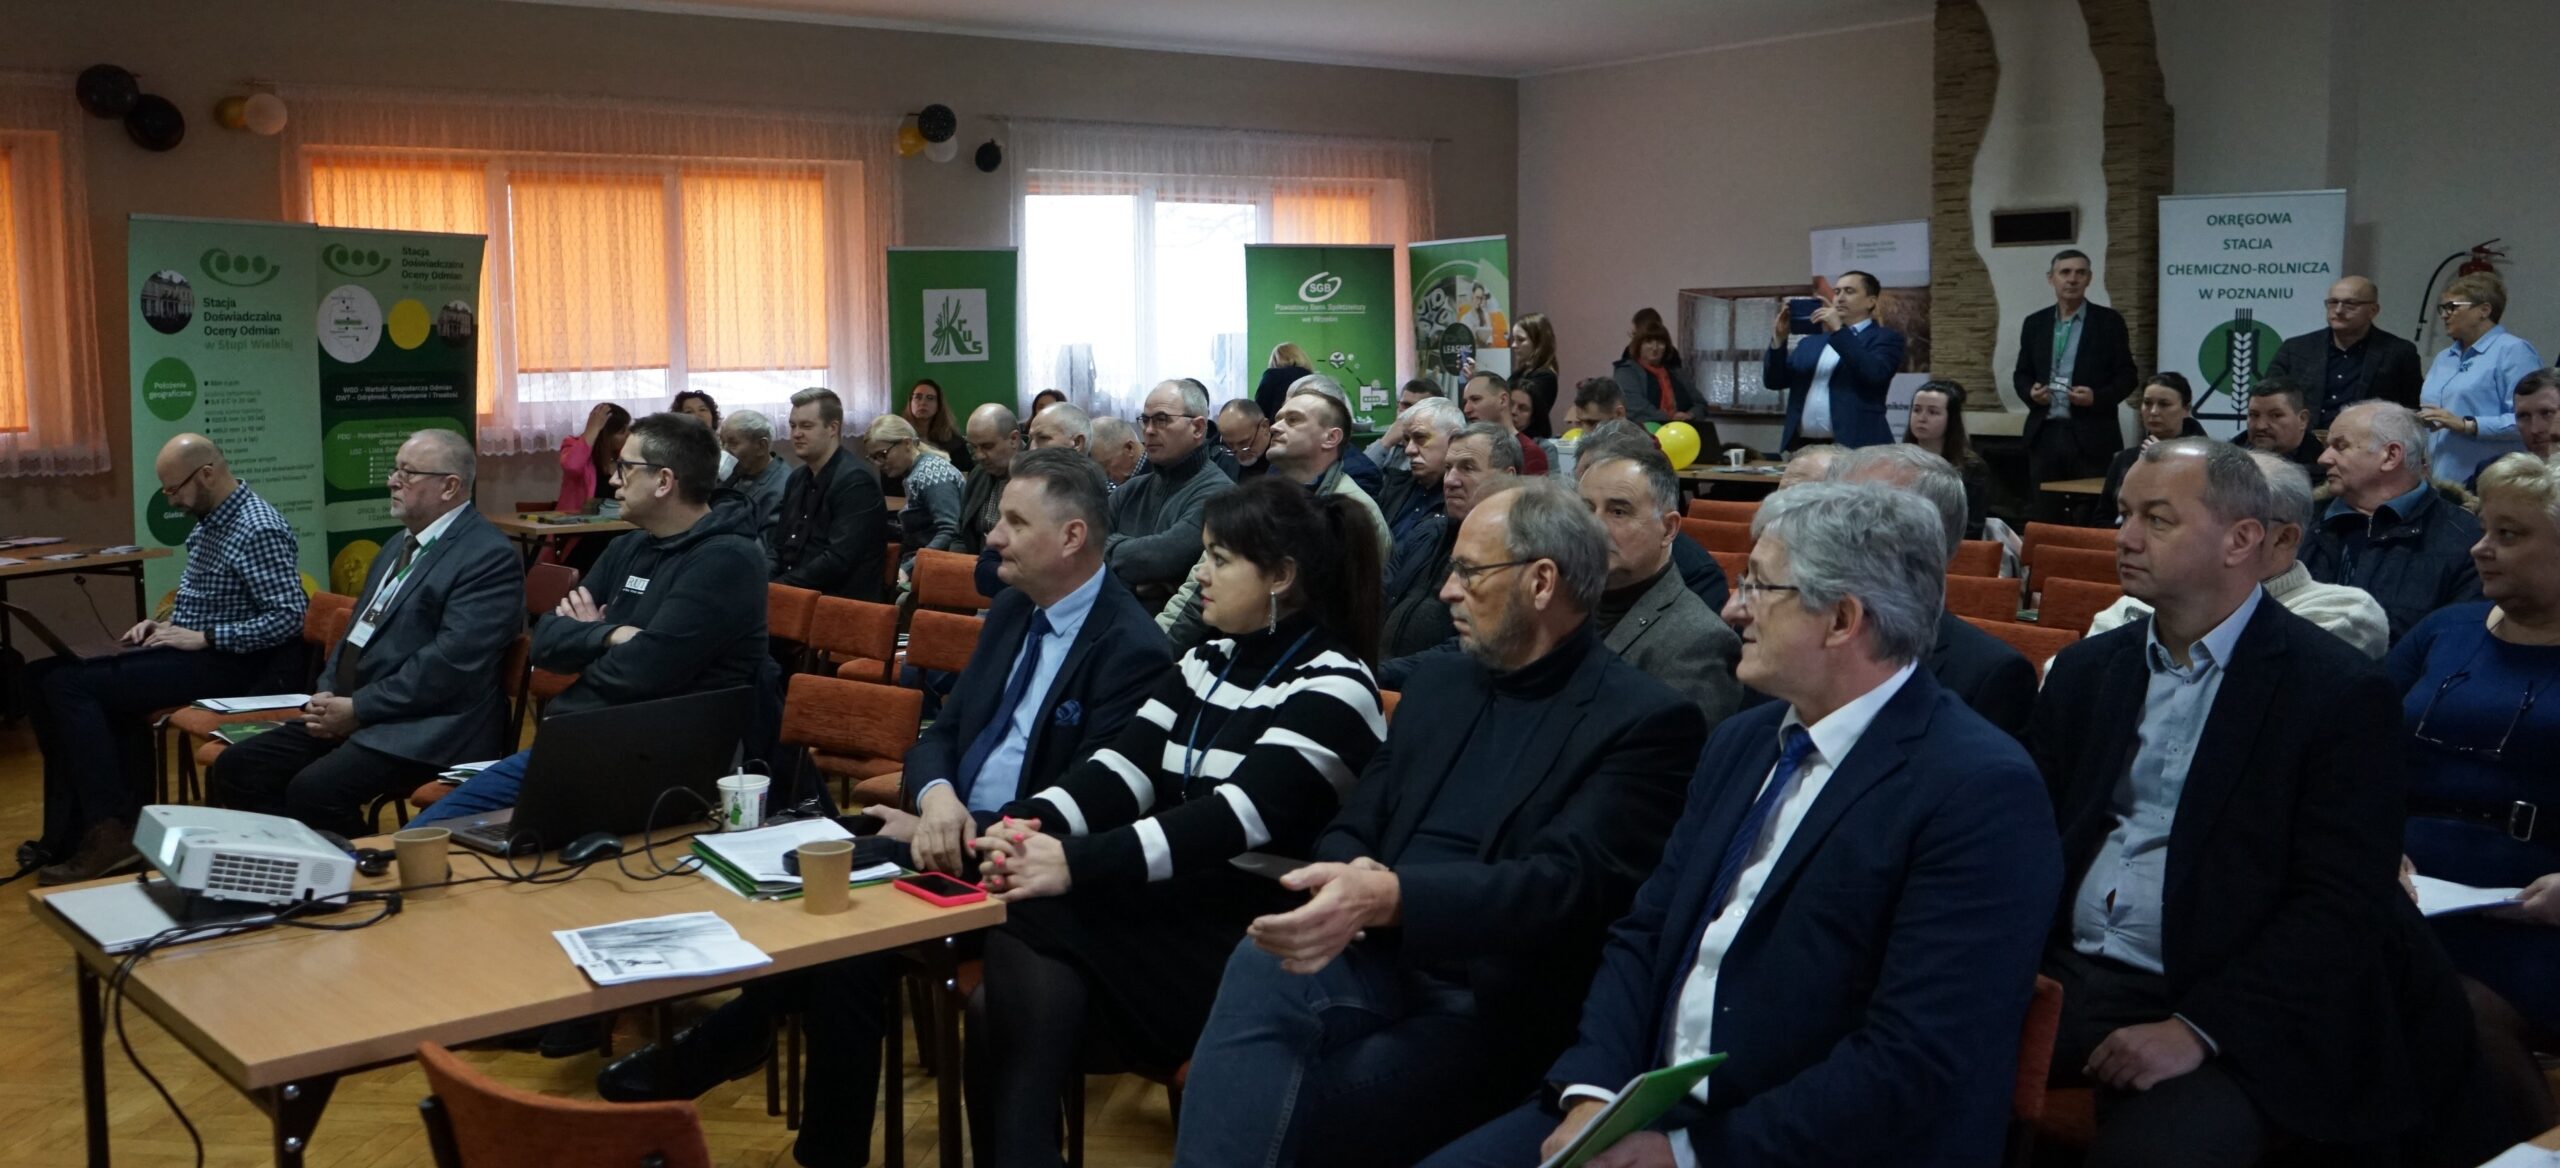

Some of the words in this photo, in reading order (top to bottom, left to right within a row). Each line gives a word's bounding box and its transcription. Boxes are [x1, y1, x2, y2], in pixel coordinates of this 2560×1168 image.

[2206, 212, 2292, 228] OKRĘGOWA
[2222, 238, 2273, 250] STACJA
[402, 247, 430, 258] Stacja
[2166, 261, 2330, 276] CHEMICZNO-ROLNICZA
[401, 271, 430, 282] Oceny
[1309, 283, 1332, 293] SGB
[2198, 288, 2213, 300] W
[2217, 287, 2294, 300] POZNANIU
[203, 297, 237, 310] Stacja
[203, 310, 282, 322] Doświadczalna
[204, 325, 238, 338] Oceny
[240, 325, 281, 336] Odmian
